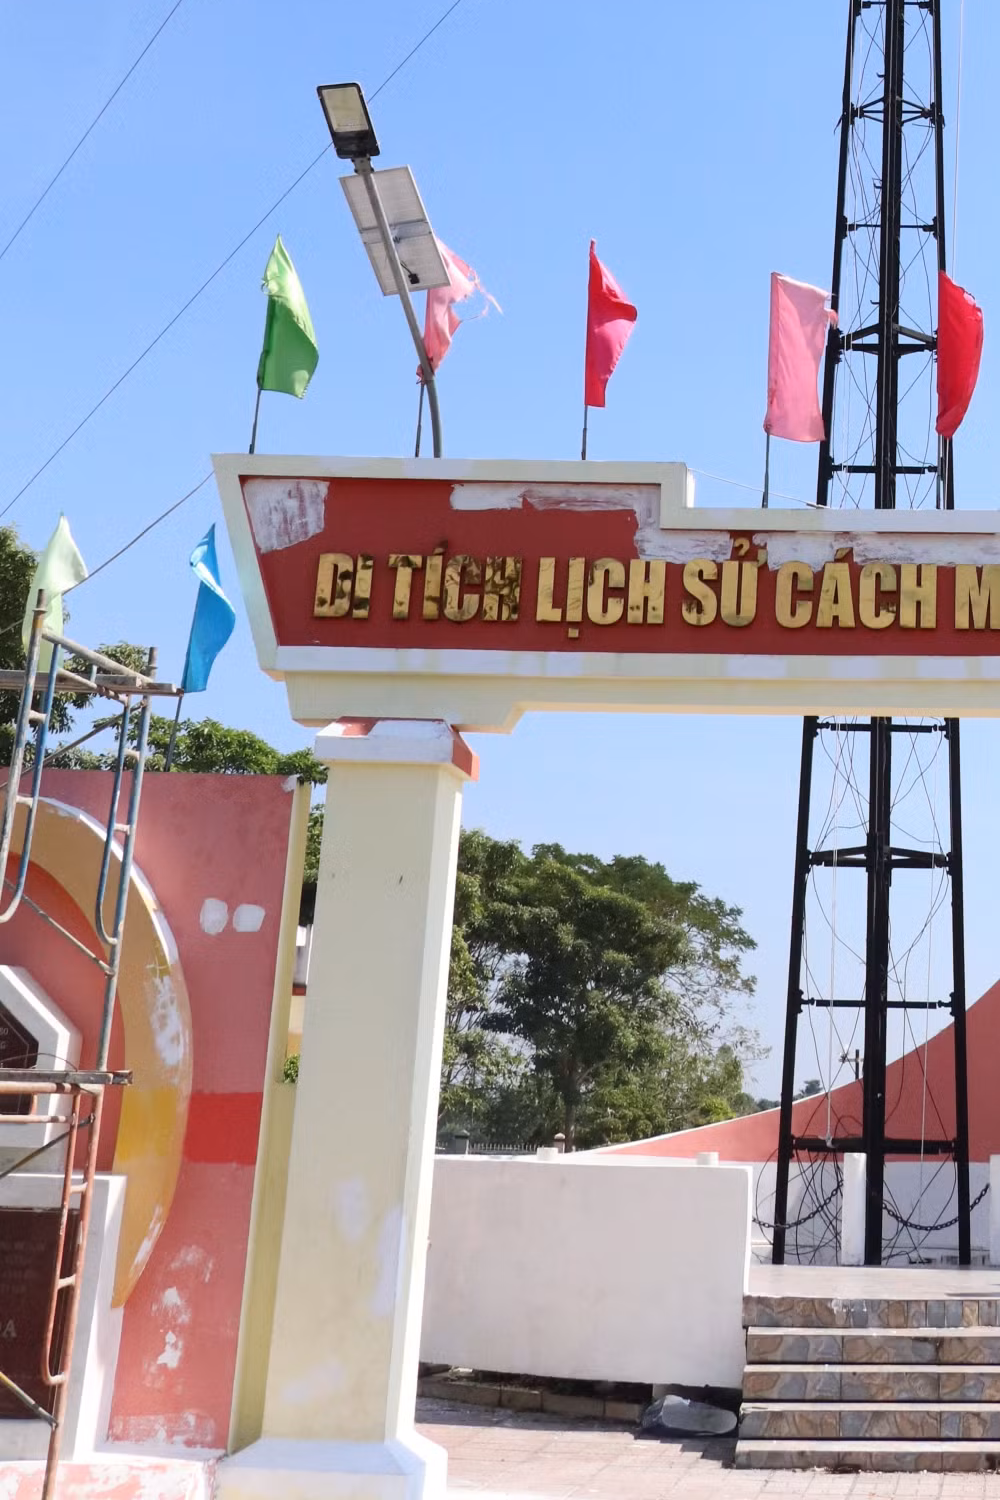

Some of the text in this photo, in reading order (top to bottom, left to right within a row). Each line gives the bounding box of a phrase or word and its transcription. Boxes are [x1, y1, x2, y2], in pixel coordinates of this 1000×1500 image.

[313, 552, 374, 619] DI
[388, 539, 524, 623] TÍCH
[535, 556, 667, 639] LỊCH
[681, 536, 768, 627] SỬ
[775, 546, 938, 630] CÁCH
